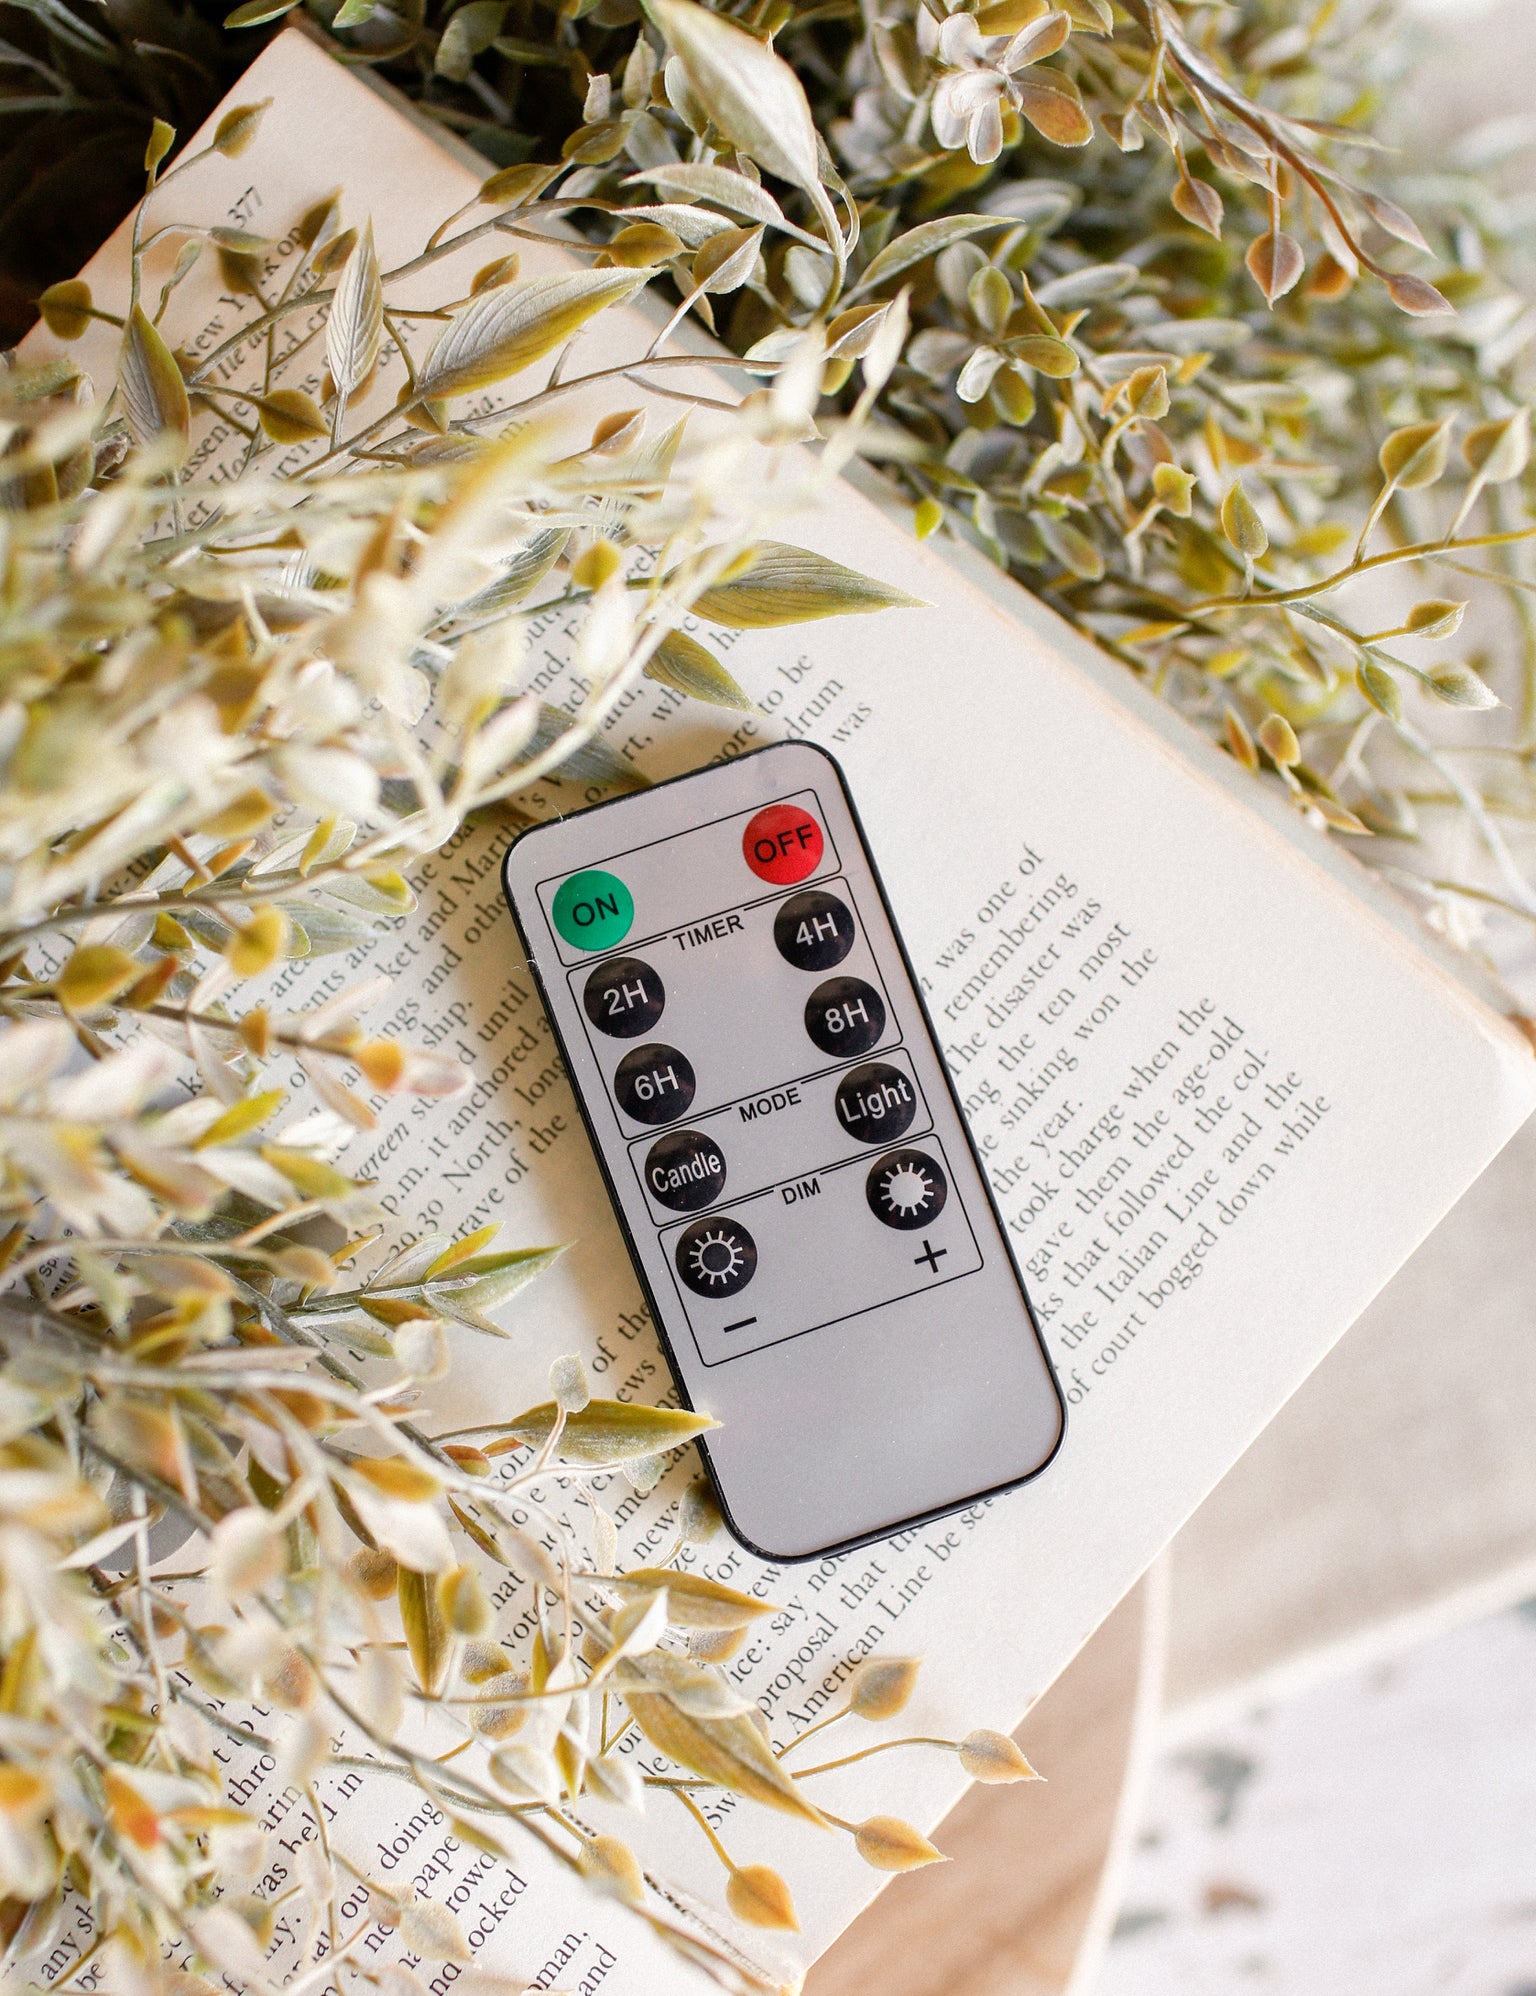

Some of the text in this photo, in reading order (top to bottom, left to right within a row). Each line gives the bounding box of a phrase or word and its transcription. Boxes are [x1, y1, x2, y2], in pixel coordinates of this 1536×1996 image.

[227, 186, 262, 228] 377
[475, 979, 531, 1042] until
[760, 690, 784, 714] to
[777, 653, 813, 685] be
[754, 825, 814, 862] OFF
[416, 885, 464, 942] and
[574, 897, 619, 928] ON
[673, 916, 745, 951] TIMER
[795, 914, 838, 945] 4H
[420, 938, 468, 995] and
[440, 1104, 524, 1193] North,
[831, 702, 872, 744] was
[941, 871, 1079, 1023] remembering
[603, 982, 650, 1015] 2H
[942, 1027, 987, 1075] The
[982, 941, 1061, 1029] disaster
[1060, 897, 1102, 939] was
[996, 1031, 1036, 1072] the
[1037, 987, 1076, 1026] ten
[1078, 922, 1131, 982] most
[419, 985, 481, 1049] ship.
[825, 1001, 869, 1033] 8H
[997, 1045, 1079, 1132] sinking
[1073, 993, 1120, 1040] won
[1119, 946, 1158, 987] the
[589, 843, 1044, 1374] of the was one of
[635, 1067, 679, 1101] 6H
[740, 1088, 802, 1122] MODE
[841, 1079, 910, 1123] Light
[382, 1161, 433, 1216] p.m.
[420, 1134, 449, 1158] it
[446, 1024, 541, 1136] anchored
[1001, 1179, 1060, 1234] took
[1055, 1102, 1127, 1181] charge
[1120, 1039, 1180, 1100] when
[1176, 996, 1216, 1037] the
[502, 1147, 537, 1185] of
[527, 1112, 568, 1155] the
[652, 1151, 721, 1191] Candle
[984, 1154, 1030, 1195] the
[1029, 1098, 1085, 1159] year.
[1024, 1220, 1076, 1283] gave
[1073, 1153, 1132, 1215] them
[1130, 1107, 1170, 1149] the
[1169, 1015, 1246, 1107] age-old
[782, 1179, 821, 1206] DIM
[770, 1597, 813, 1642] say
[1060, 1235, 1110, 1288] that
[1102, 1133, 1195, 1237] followed
[1192, 1093, 1233, 1134] the
[1230, 1045, 1270, 1092] col-
[747, 1614, 844, 1721] proposal
[838, 1559, 887, 1610] that
[1058, 1309, 1099, 1350] the
[1093, 1228, 1169, 1305] Italian
[1163, 1167, 1220, 1224] Line
[1219, 1111, 1263, 1164] and
[1262, 1069, 1303, 1111] the
[784, 1622, 885, 1735] American
[875, 1563, 933, 1621] Line
[924, 1529, 961, 1562] be
[1055, 1368, 1091, 1405] of
[1090, 1312, 1147, 1376] court
[1137, 1221, 1221, 1311] bogged
[1213, 1160, 1276, 1226] down
[1271, 1093, 1331, 1157] while
[329, 1763, 364, 1800] in
[374, 1798, 444, 1871] doing
[40, 1930, 83, 1986] any
[571, 1946, 618, 1994] and
